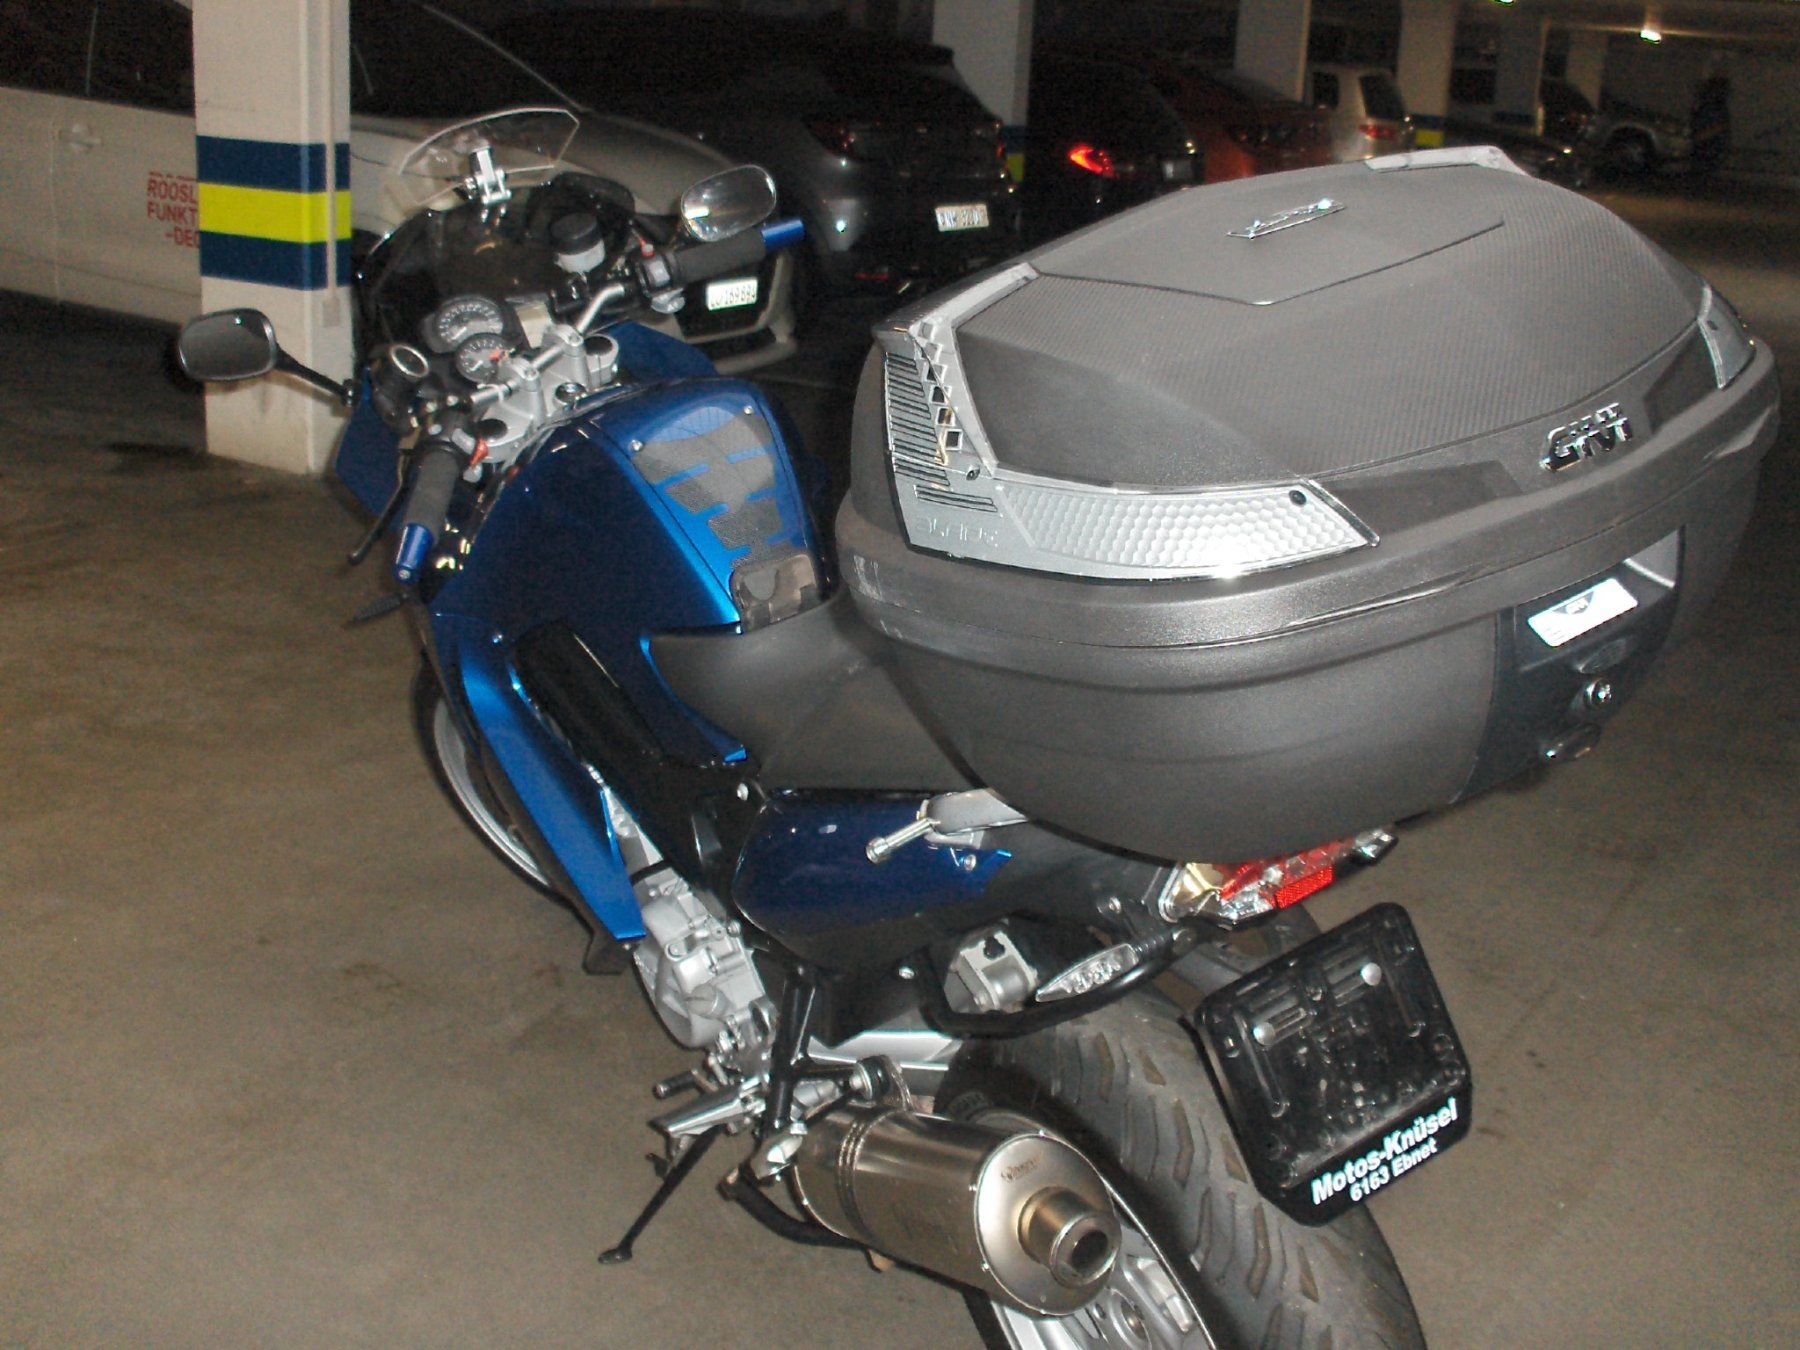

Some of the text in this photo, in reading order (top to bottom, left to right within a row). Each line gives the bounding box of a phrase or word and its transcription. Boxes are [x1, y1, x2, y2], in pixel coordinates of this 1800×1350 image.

[1539, 402, 1632, 472] GIVI
[1311, 1097, 1458, 1205] Motos-Knüsel
[1350, 1136, 1438, 1202] 6163 Ebnet
